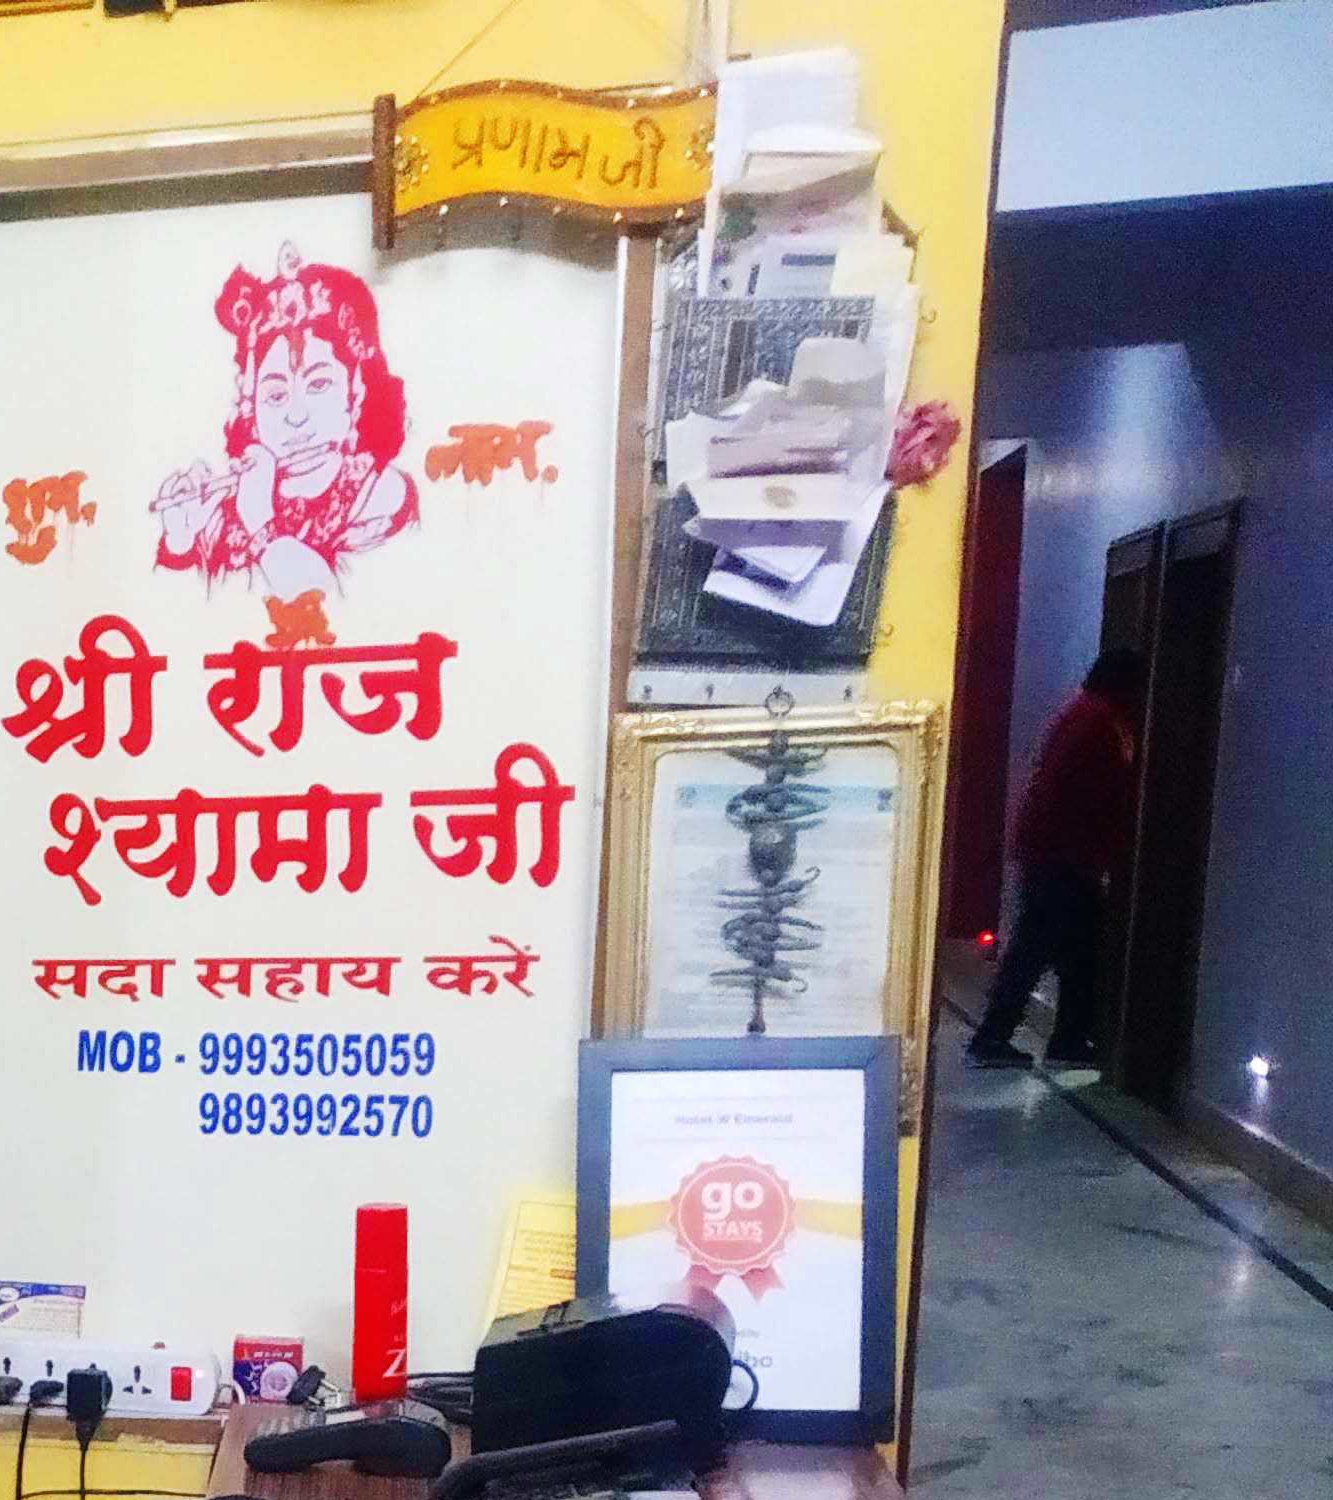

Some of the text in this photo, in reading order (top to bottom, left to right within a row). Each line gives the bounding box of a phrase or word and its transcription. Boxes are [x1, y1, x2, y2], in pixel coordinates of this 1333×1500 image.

[0, 614, 459, 765] श्री राज
[44, 741, 576, 906] श्यामा जी
[32, 934, 541, 1003] सदा सहाय करें
[76, 1029, 163, 1075] MOB
[197, 1031, 435, 1078] 9993505059
[197, 1092, 434, 1138] 9893992570
[700, 1181, 765, 1222] go
[703, 1219, 764, 1242] STAYS
